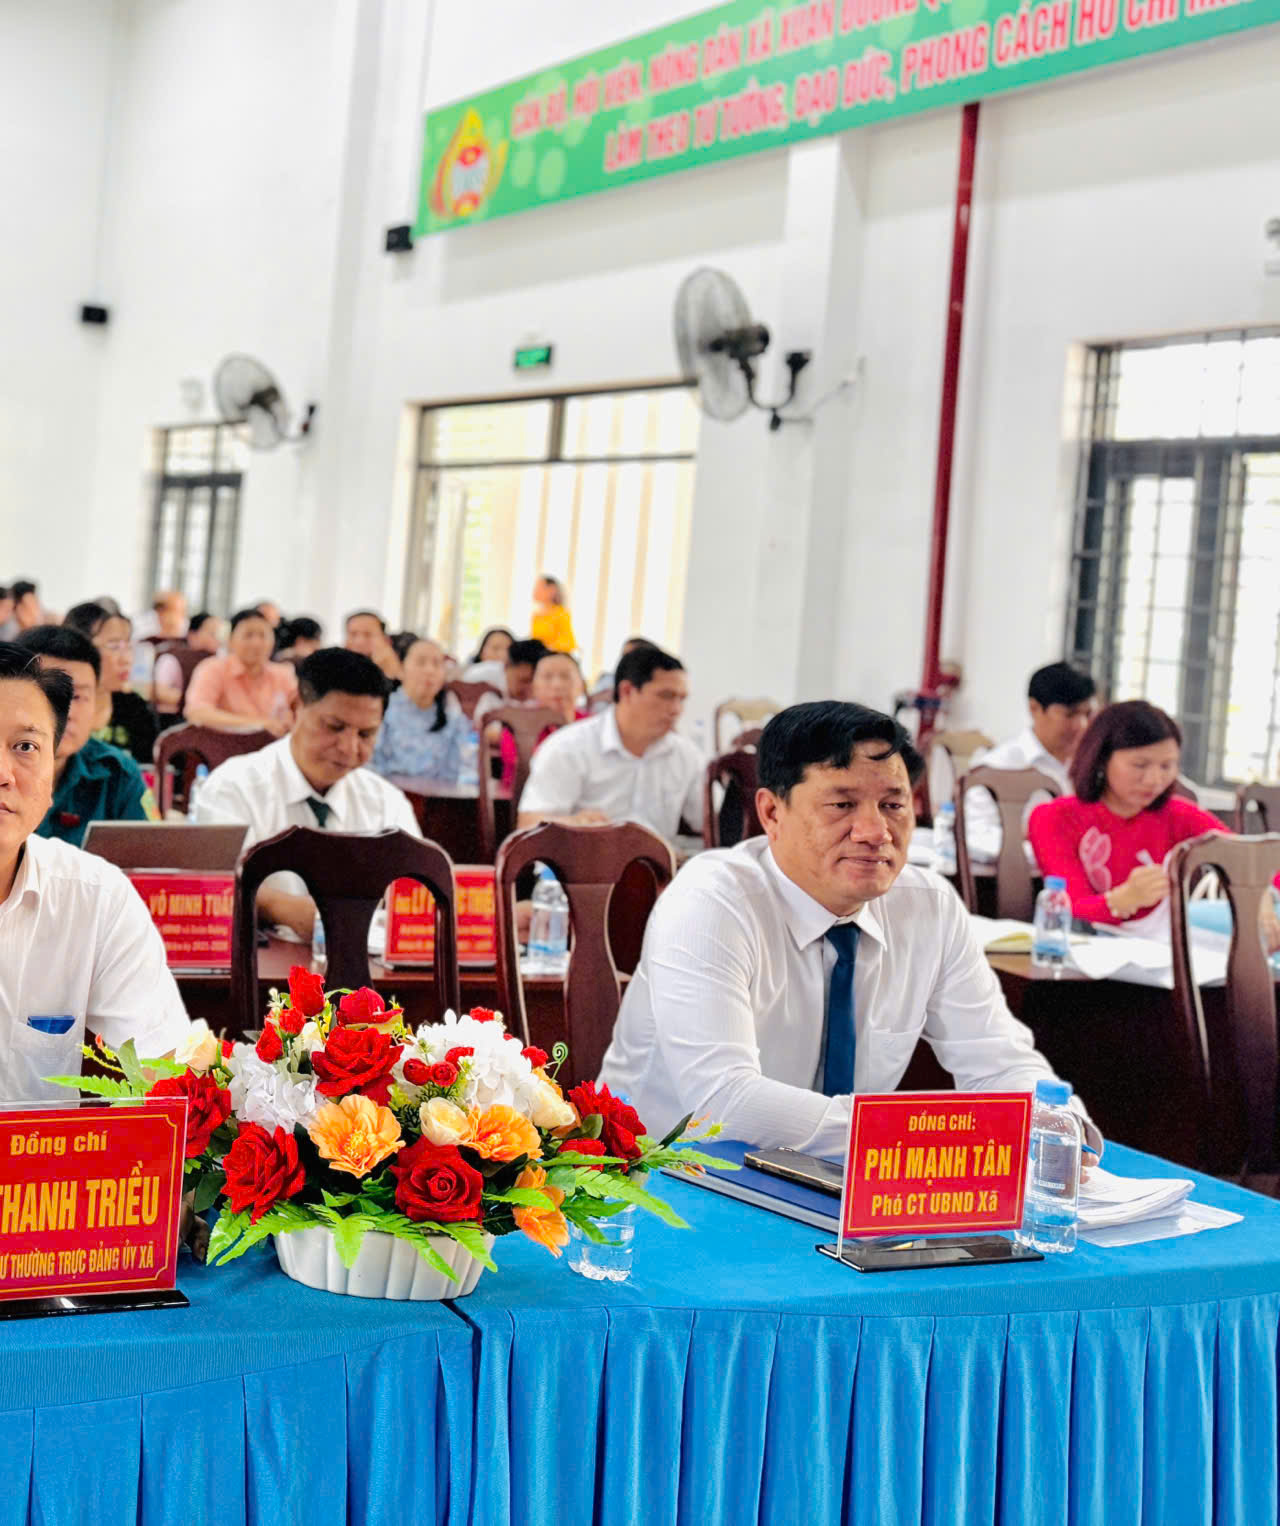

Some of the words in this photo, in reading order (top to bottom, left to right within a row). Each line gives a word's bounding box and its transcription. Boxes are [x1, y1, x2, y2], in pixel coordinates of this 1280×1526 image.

[649, 41, 699, 93] NÔNG
[702, 23, 742, 78] DÂN
[745, 8, 775, 64] XÃ
[778, 0, 835, 54] XUÂN
[604, 119, 643, 173] LÀM
[646, 110, 690, 161] THEO
[693, 98, 718, 148] TƯ
[794, 67, 840, 127] ĐẠO
[841, 44, 896, 107] ĐỨC,
[900, 22, 992, 93] PHONG
[993, 0, 1072, 67] CÁCH
[168, 894, 202, 916] MINH
[908, 1110, 947, 1132] ĐỒNG
[949, 1111, 977, 1131] CHÍ:
[10, 1131, 67, 1156] Đồng
[73, 1130, 107, 1153] chí
[864, 1141, 902, 1181] PHÍ
[905, 1145, 968, 1186] MẠNH
[973, 1138, 1012, 1177] TÂN
[86, 1160, 160, 1229] TRIỀU
[871, 1193, 903, 1217] Phó
[906, 1193, 928, 1215] CT
[929, 1191, 975, 1215] UBND
[976, 1190, 998, 1213] Xã
[10, 1247, 56, 1280] THƯỜNG
[58, 1247, 87, 1280] TRỰC
[89, 1243, 120, 1273] ĐẢNG
[122, 1237, 137, 1270] ỦY
[138, 1238, 155, 1269] XÃ
